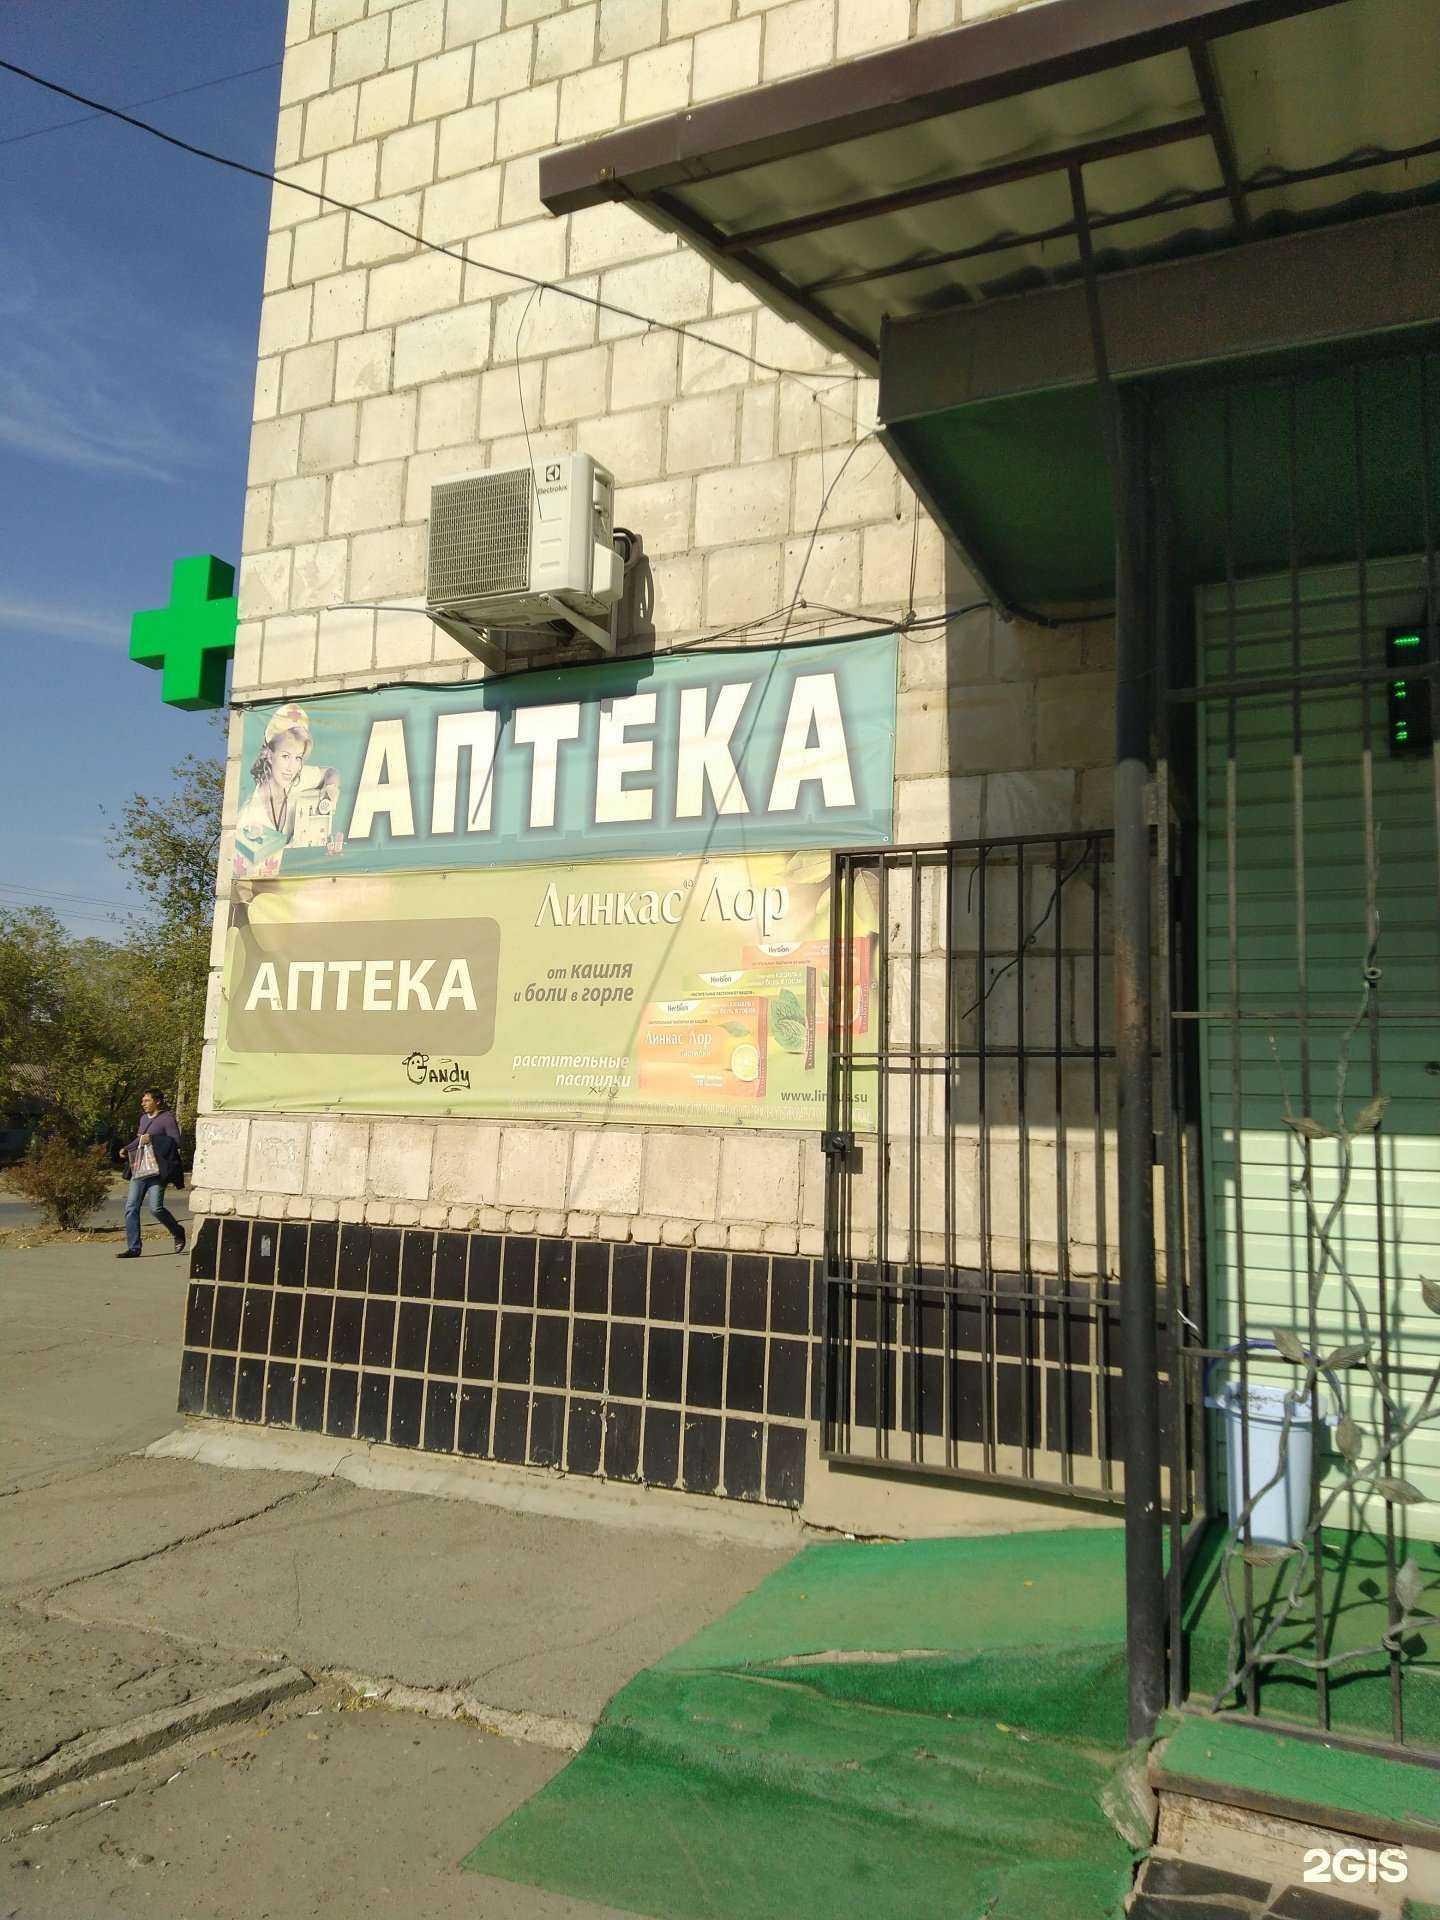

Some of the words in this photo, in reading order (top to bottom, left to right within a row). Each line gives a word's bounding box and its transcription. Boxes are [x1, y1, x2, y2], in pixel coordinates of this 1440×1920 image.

[347, 673, 856, 840] АПТЕКА
[700, 876, 791, 938] Лор
[546, 967, 567, 981] от
[570, 961, 633, 980] кашля
[243, 958, 478, 1012] АПТЕКА
[513, 991, 522, 1003] и
[524, 983, 568, 1003] боли
[571, 990, 578, 1002] в
[581, 987, 634, 1007] горле
[512, 1054, 630, 1071] растительные
[555, 1073, 632, 1089] пастилки
